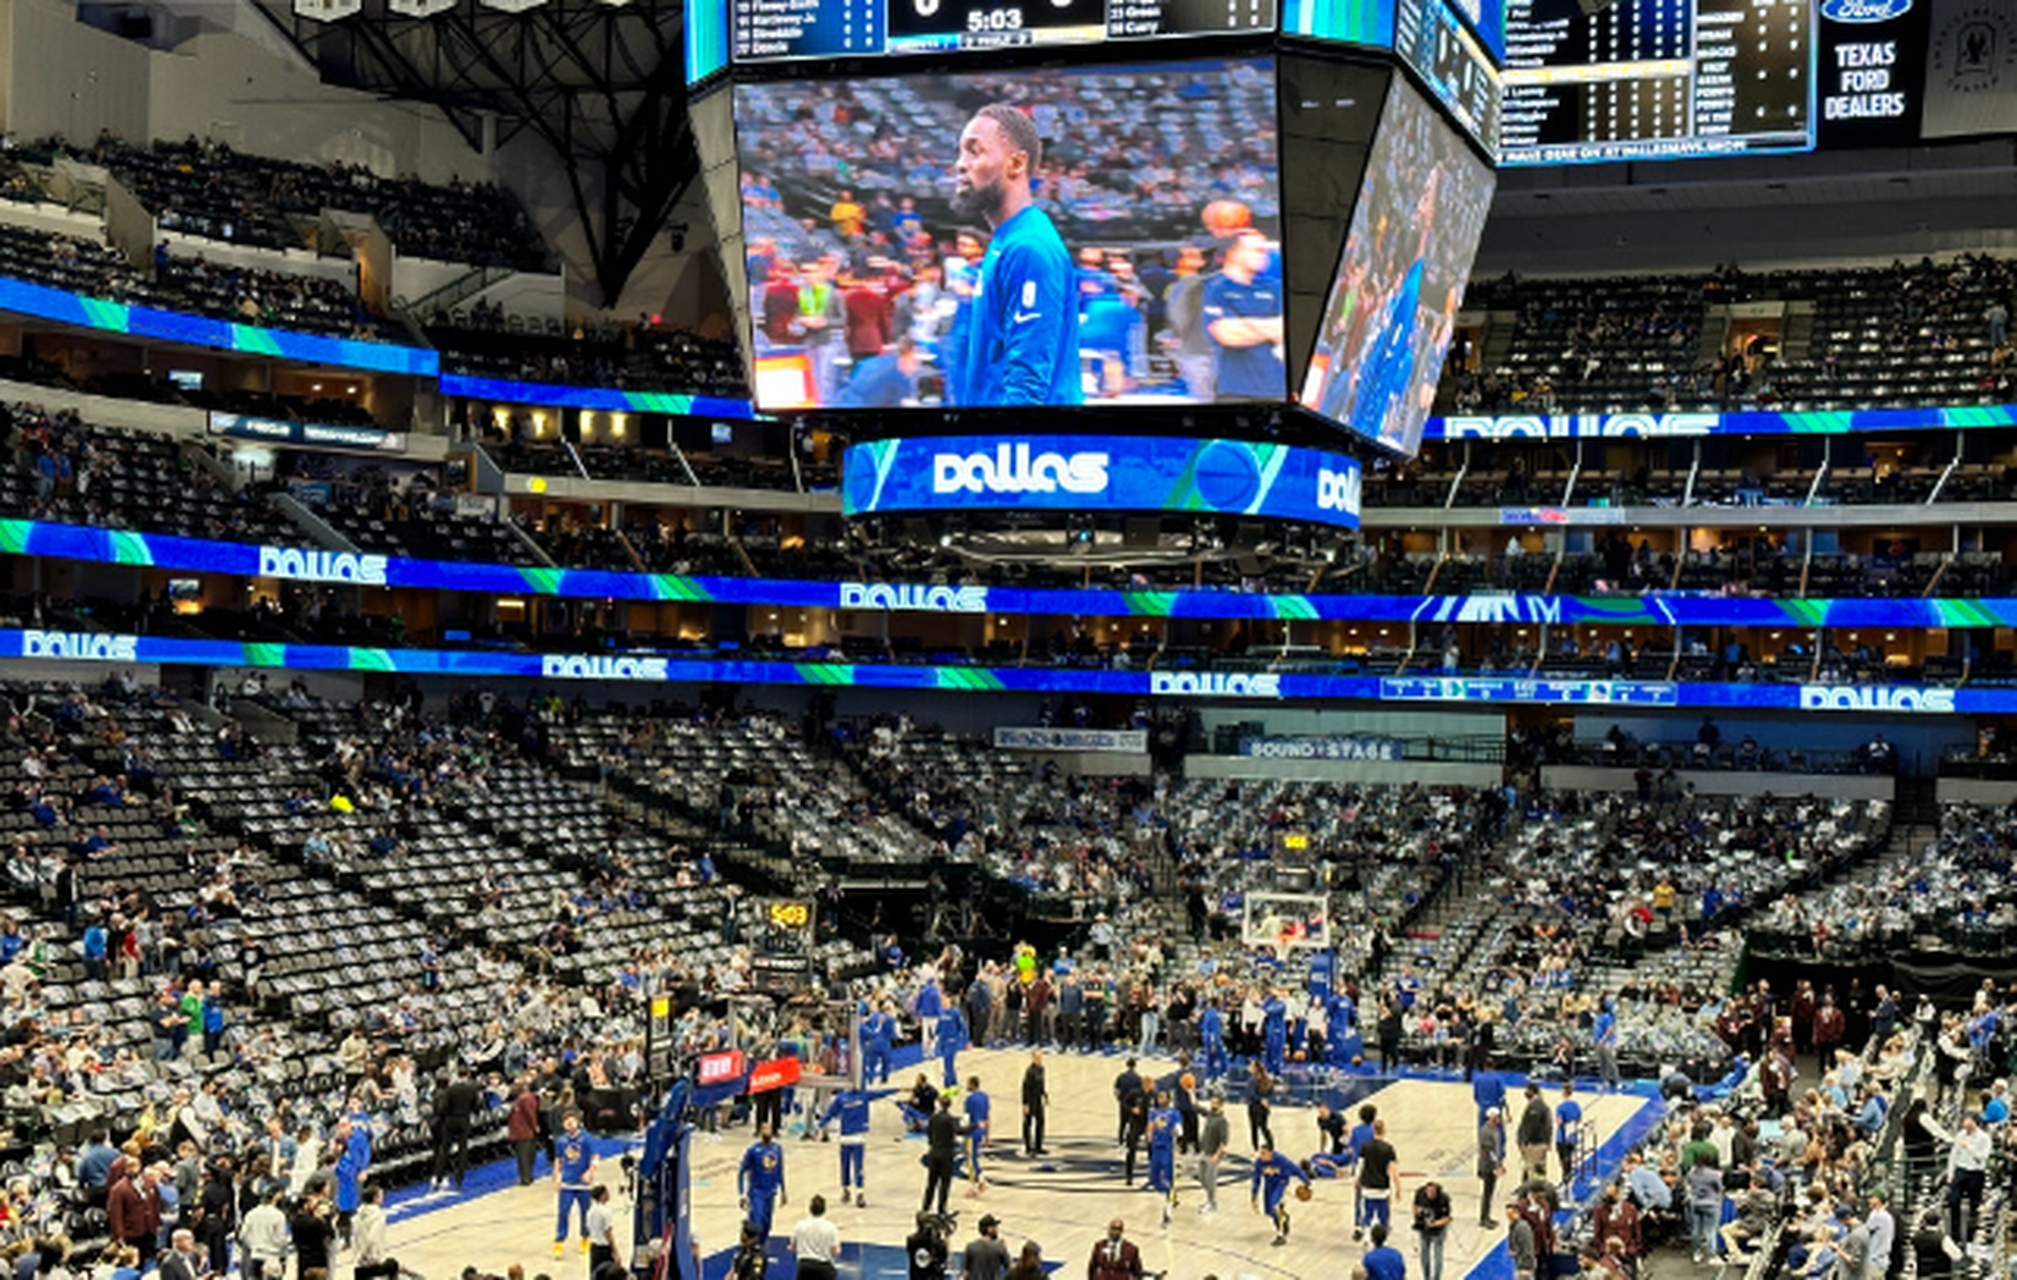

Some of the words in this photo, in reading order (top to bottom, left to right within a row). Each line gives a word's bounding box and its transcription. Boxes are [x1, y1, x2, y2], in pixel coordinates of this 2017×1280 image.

[967, 9, 1023, 31] 5:03
[1834, 41, 1896, 67] TEXAS
[1841, 69, 1890, 92] FORD
[1825, 93, 1905, 120] DEALERS
[1251, 742, 1315, 757] SOUND
[1326, 742, 1392, 760] STAGE
